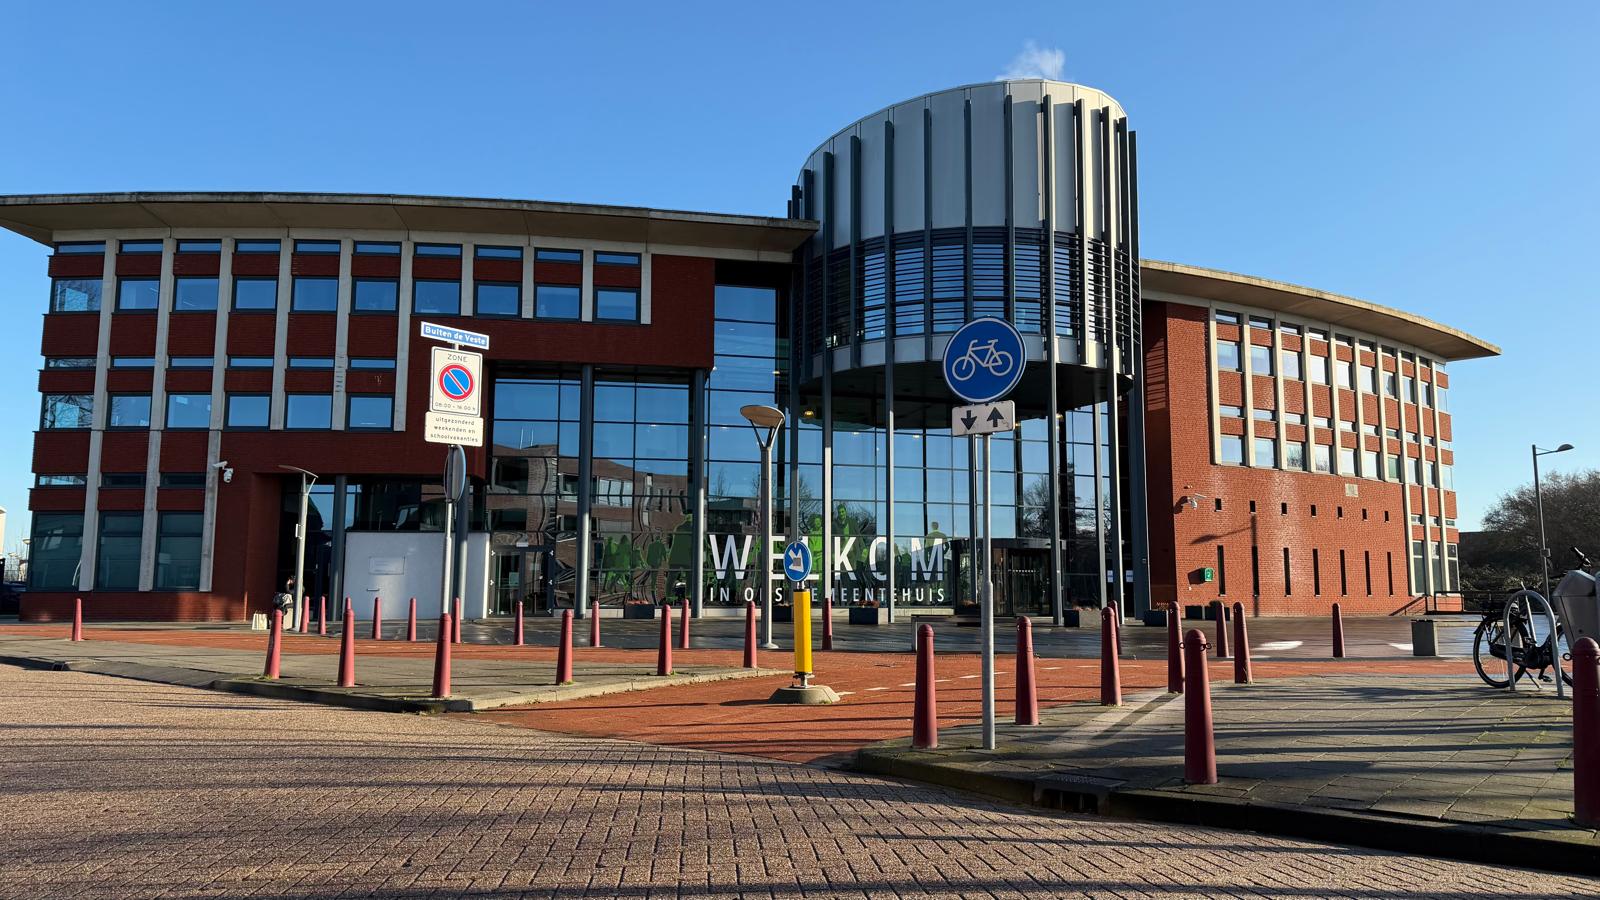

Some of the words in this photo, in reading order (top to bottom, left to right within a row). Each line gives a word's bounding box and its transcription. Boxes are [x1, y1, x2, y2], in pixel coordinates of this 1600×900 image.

[425, 325, 452, 338] Buiten
[453, 331, 463, 340] de
[464, 334, 486, 345] Veste
[447, 353, 468, 363] ZONE
[435, 417, 475, 426] uitgezonderd
[433, 425, 467, 433] weekenden
[430, 433, 478, 442] schoolvakanties
[710, 587, 730, 602] IN
[744, 587, 783, 602] OS
[811, 587, 945, 602] EEENTEHUIS
